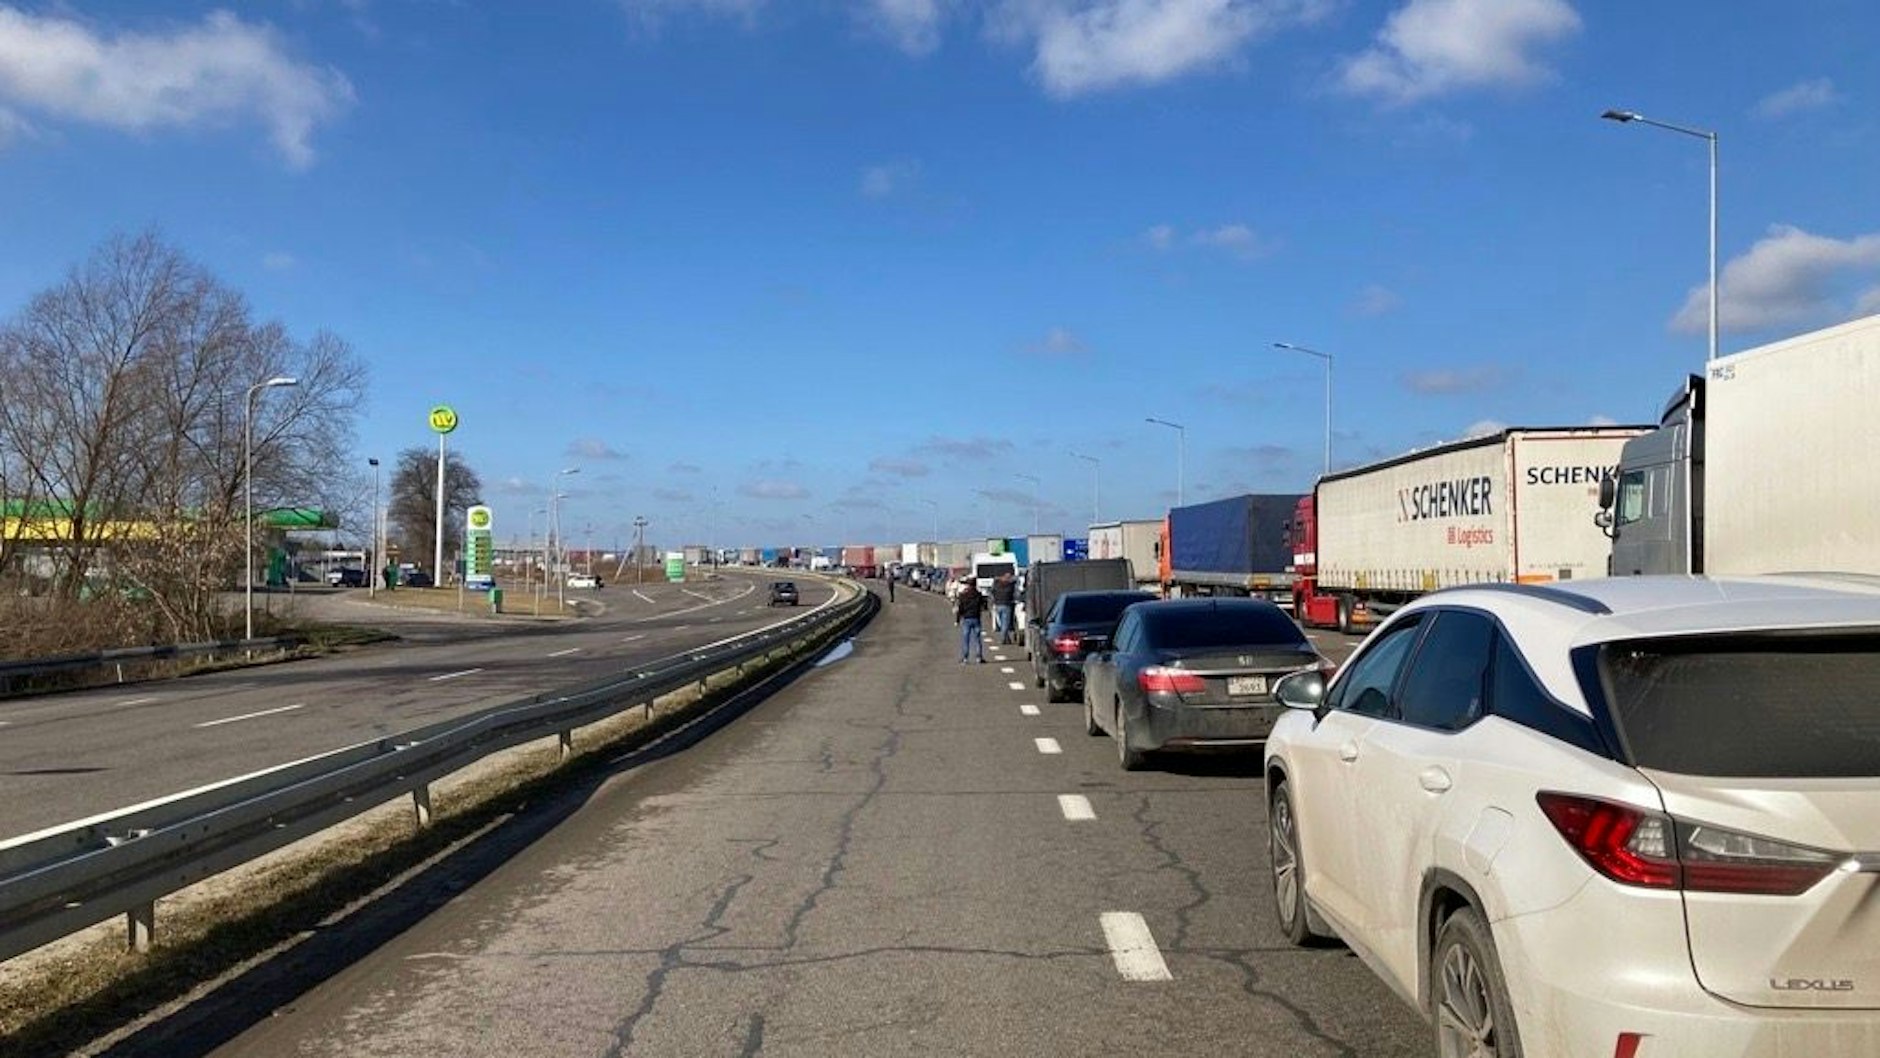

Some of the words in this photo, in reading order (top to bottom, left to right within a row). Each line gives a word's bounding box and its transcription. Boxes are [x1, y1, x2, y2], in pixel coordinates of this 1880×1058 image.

[1527, 466, 1616, 485] SCHENK
[1412, 476, 1492, 520] SCHENKER
[1458, 525, 1493, 547] Logistics
[1770, 978, 1854, 991] LEXUS
